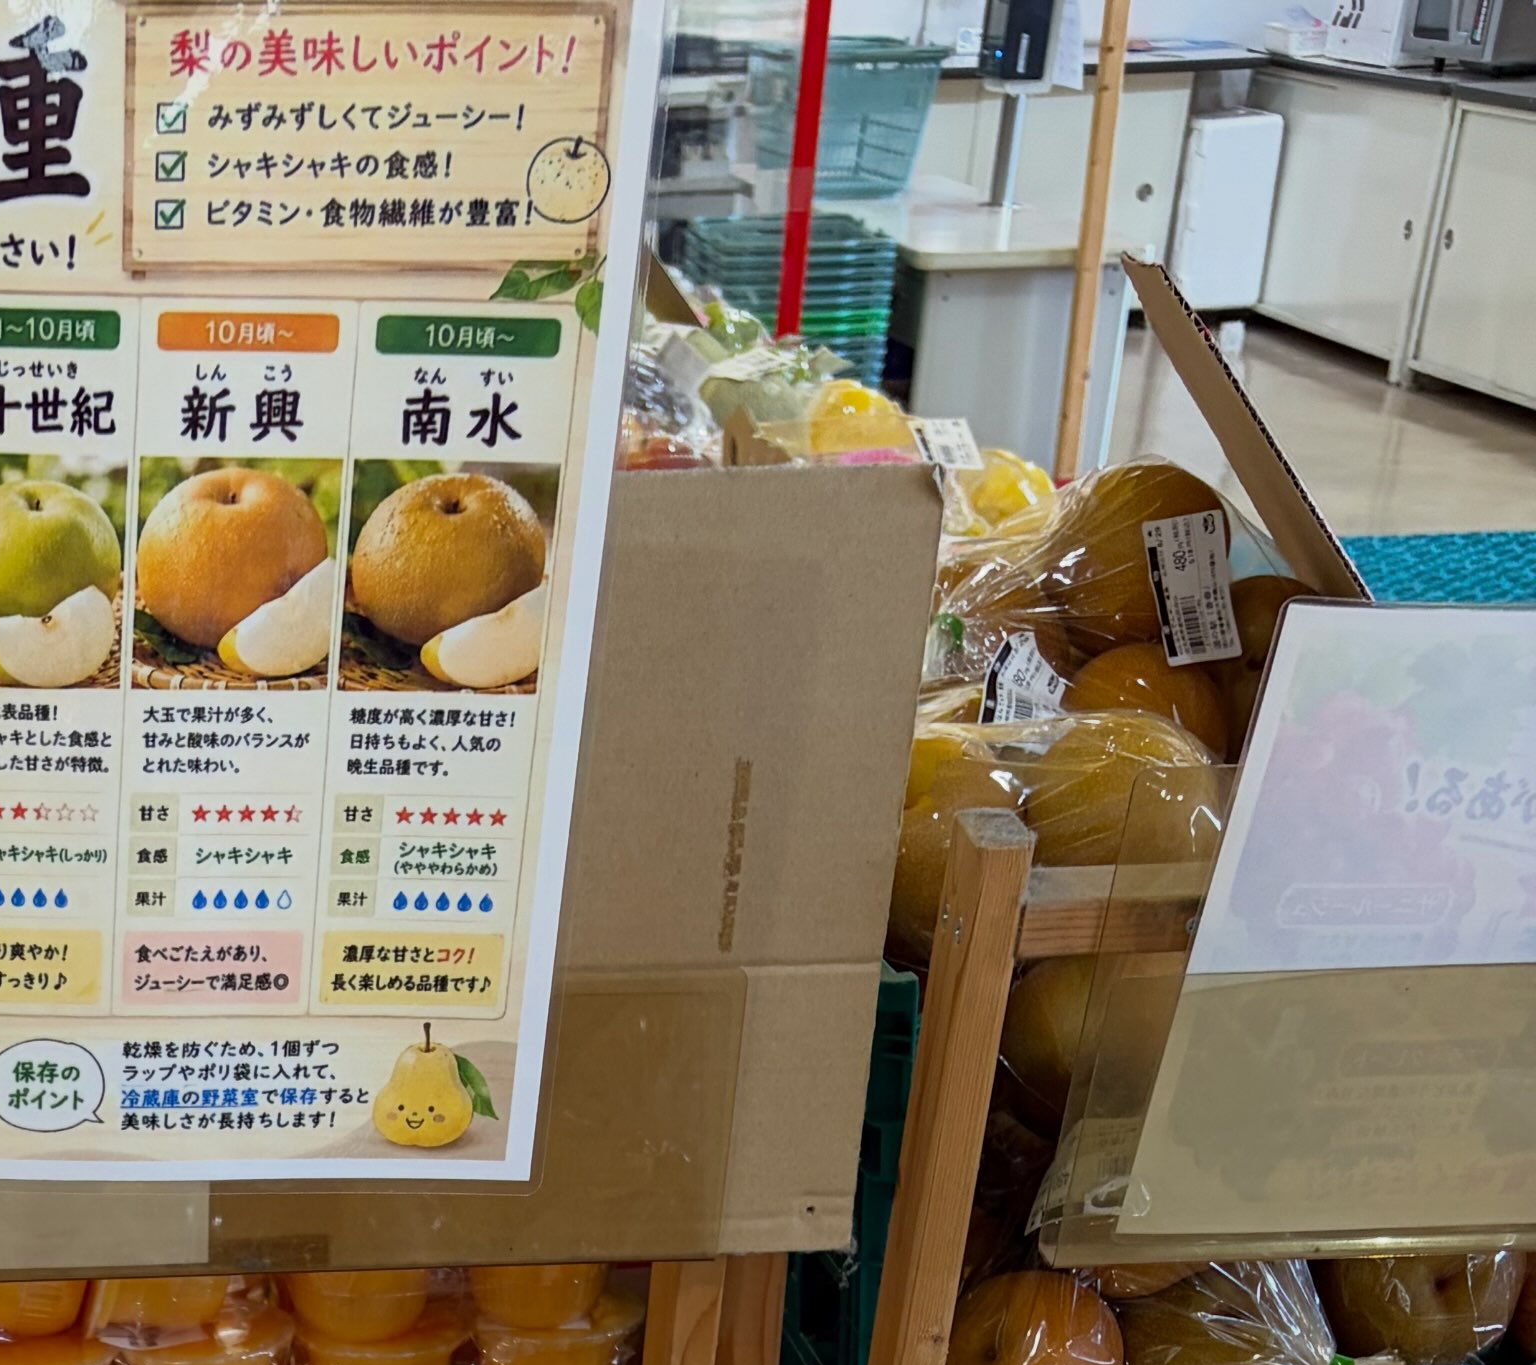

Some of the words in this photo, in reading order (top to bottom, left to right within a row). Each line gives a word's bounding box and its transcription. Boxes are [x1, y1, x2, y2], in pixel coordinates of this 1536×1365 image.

[170, 28, 578, 79] 梨の美味しいポイント!
[207, 102, 526, 134] みずみずしくてジューシー!
[206, 150, 453, 181] シャキシャキの食感!
[204, 197, 535, 231] ビタミン・食物繊維が豊富!
[194, 365, 227, 383] しん
[263, 366, 293, 383] こう
[414, 368, 446, 385] なん
[480, 371, 514, 387] すい
[180, 389, 304, 443] 新興
[401, 393, 522, 447] 南水
[143, 705, 274, 724] 大玉で果汁が多く、
[348, 707, 515, 728] 糖度が高く濃厚な甘さ!
[143, 731, 310, 749] 甘みと酸味のバランスが
[350, 733, 501, 753] 日持ちもよく、人気の
[142, 756, 240, 774] とれた味わい。
[347, 758, 450, 777] 晩生品種です。
[343, 806, 373, 822] 甘さ
[195, 847, 293, 865] シャキシャキ
[340, 848, 370, 864] 食感
[399, 842, 496, 860] シャキシャキ
[394, 861, 499, 877] (やややわらかめ)
[338, 891, 368, 906] 果汁
[134, 944, 268, 963] 食べごたえがあり、
[343, 945, 475, 964] 濃厚な甘さとコク!
[122, 1040, 340, 1058] 乾燥を防ぐため、1個ずつ
[12, 1060, 81, 1083] 保存の
[122, 1063, 337, 1082] ラップやポリ袋に入れて、
[8, 1088, 85, 1111] ポイント
[120, 1087, 370, 1108] 冷蔵庫の野菜室で保存すると
[121, 1111, 335, 1130] 美味しさが長持ちします!
